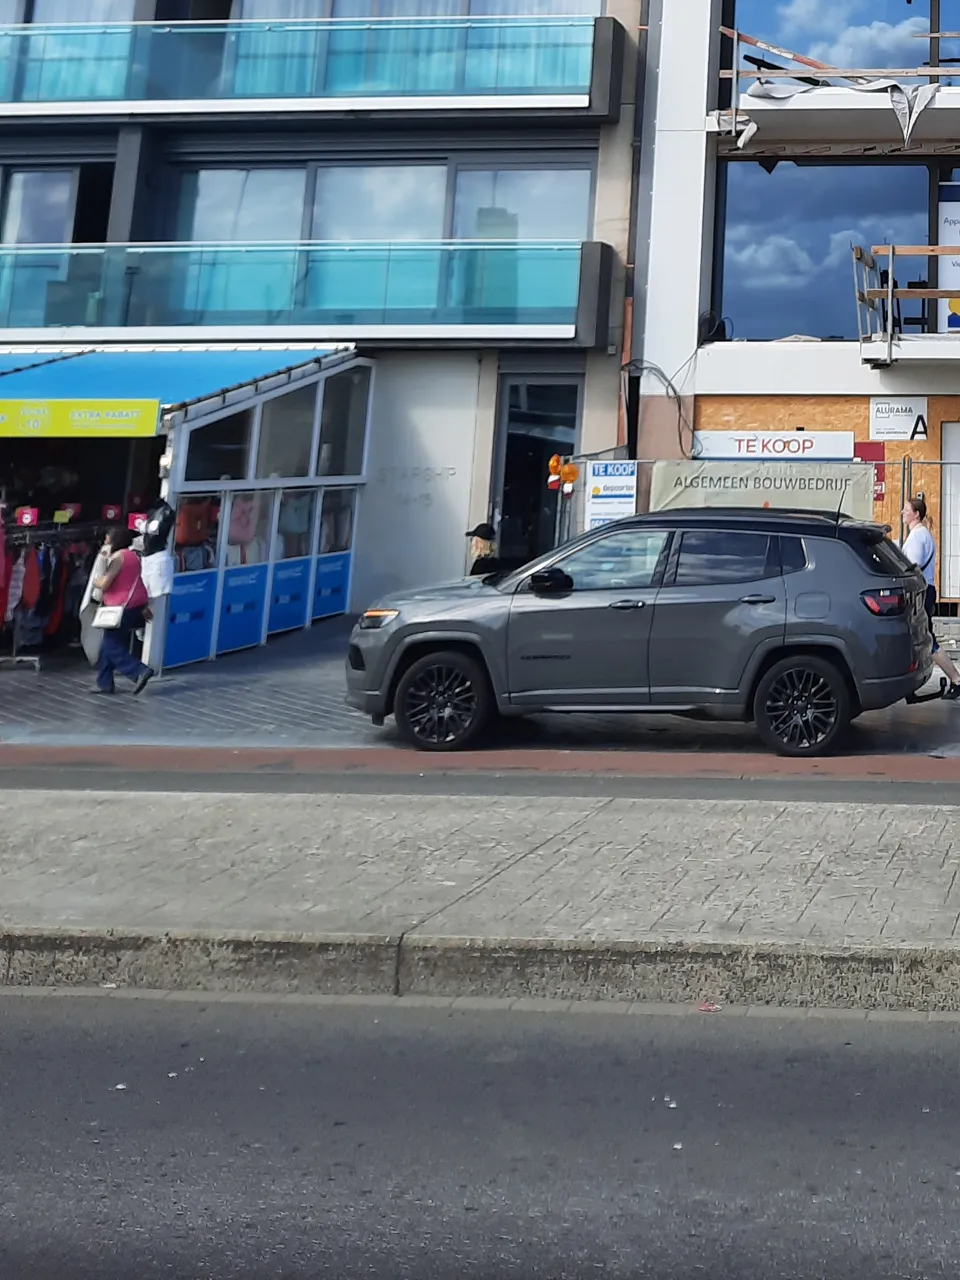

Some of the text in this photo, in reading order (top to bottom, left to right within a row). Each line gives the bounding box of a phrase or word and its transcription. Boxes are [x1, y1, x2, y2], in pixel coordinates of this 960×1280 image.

[735, 439, 814, 454] TE KOOP
[594, 464, 635, 476] TE KOOP
[674, 476, 852, 491] ALGEMEEN BOUWBEDRIJF
